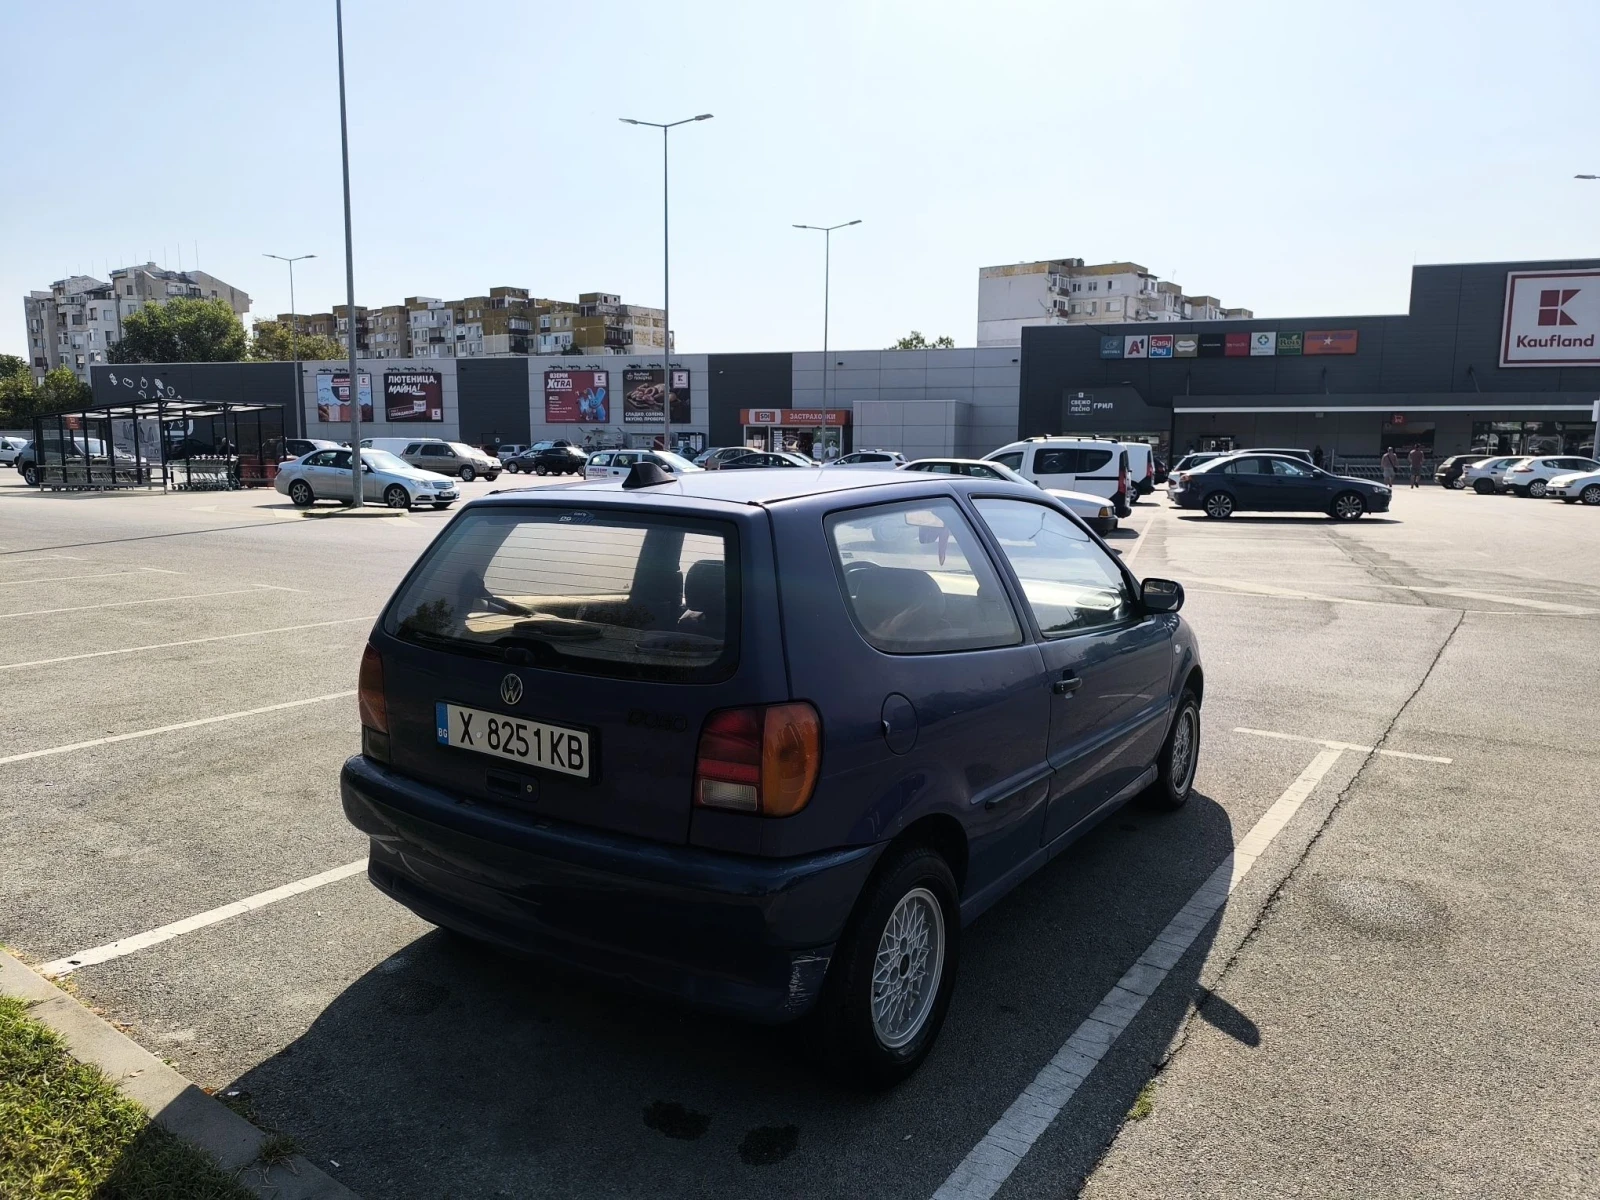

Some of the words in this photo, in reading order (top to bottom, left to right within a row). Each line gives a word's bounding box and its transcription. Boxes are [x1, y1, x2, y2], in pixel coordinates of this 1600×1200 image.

[1151, 339, 1171, 348] Easy
[1516, 334, 1595, 348] Kaufland
[1128, 338, 1144, 355] A1
[1151, 347, 1166, 355] Pay
[388, 376, 437, 384] ЛЮТЕНИЦА,
[388, 384, 420, 394] МАЙНА!
[438, 728, 448, 738] BG
[459, 711, 473, 746] X
[488, 718, 542, 762] 8251
[550, 730, 584, 771] KB
